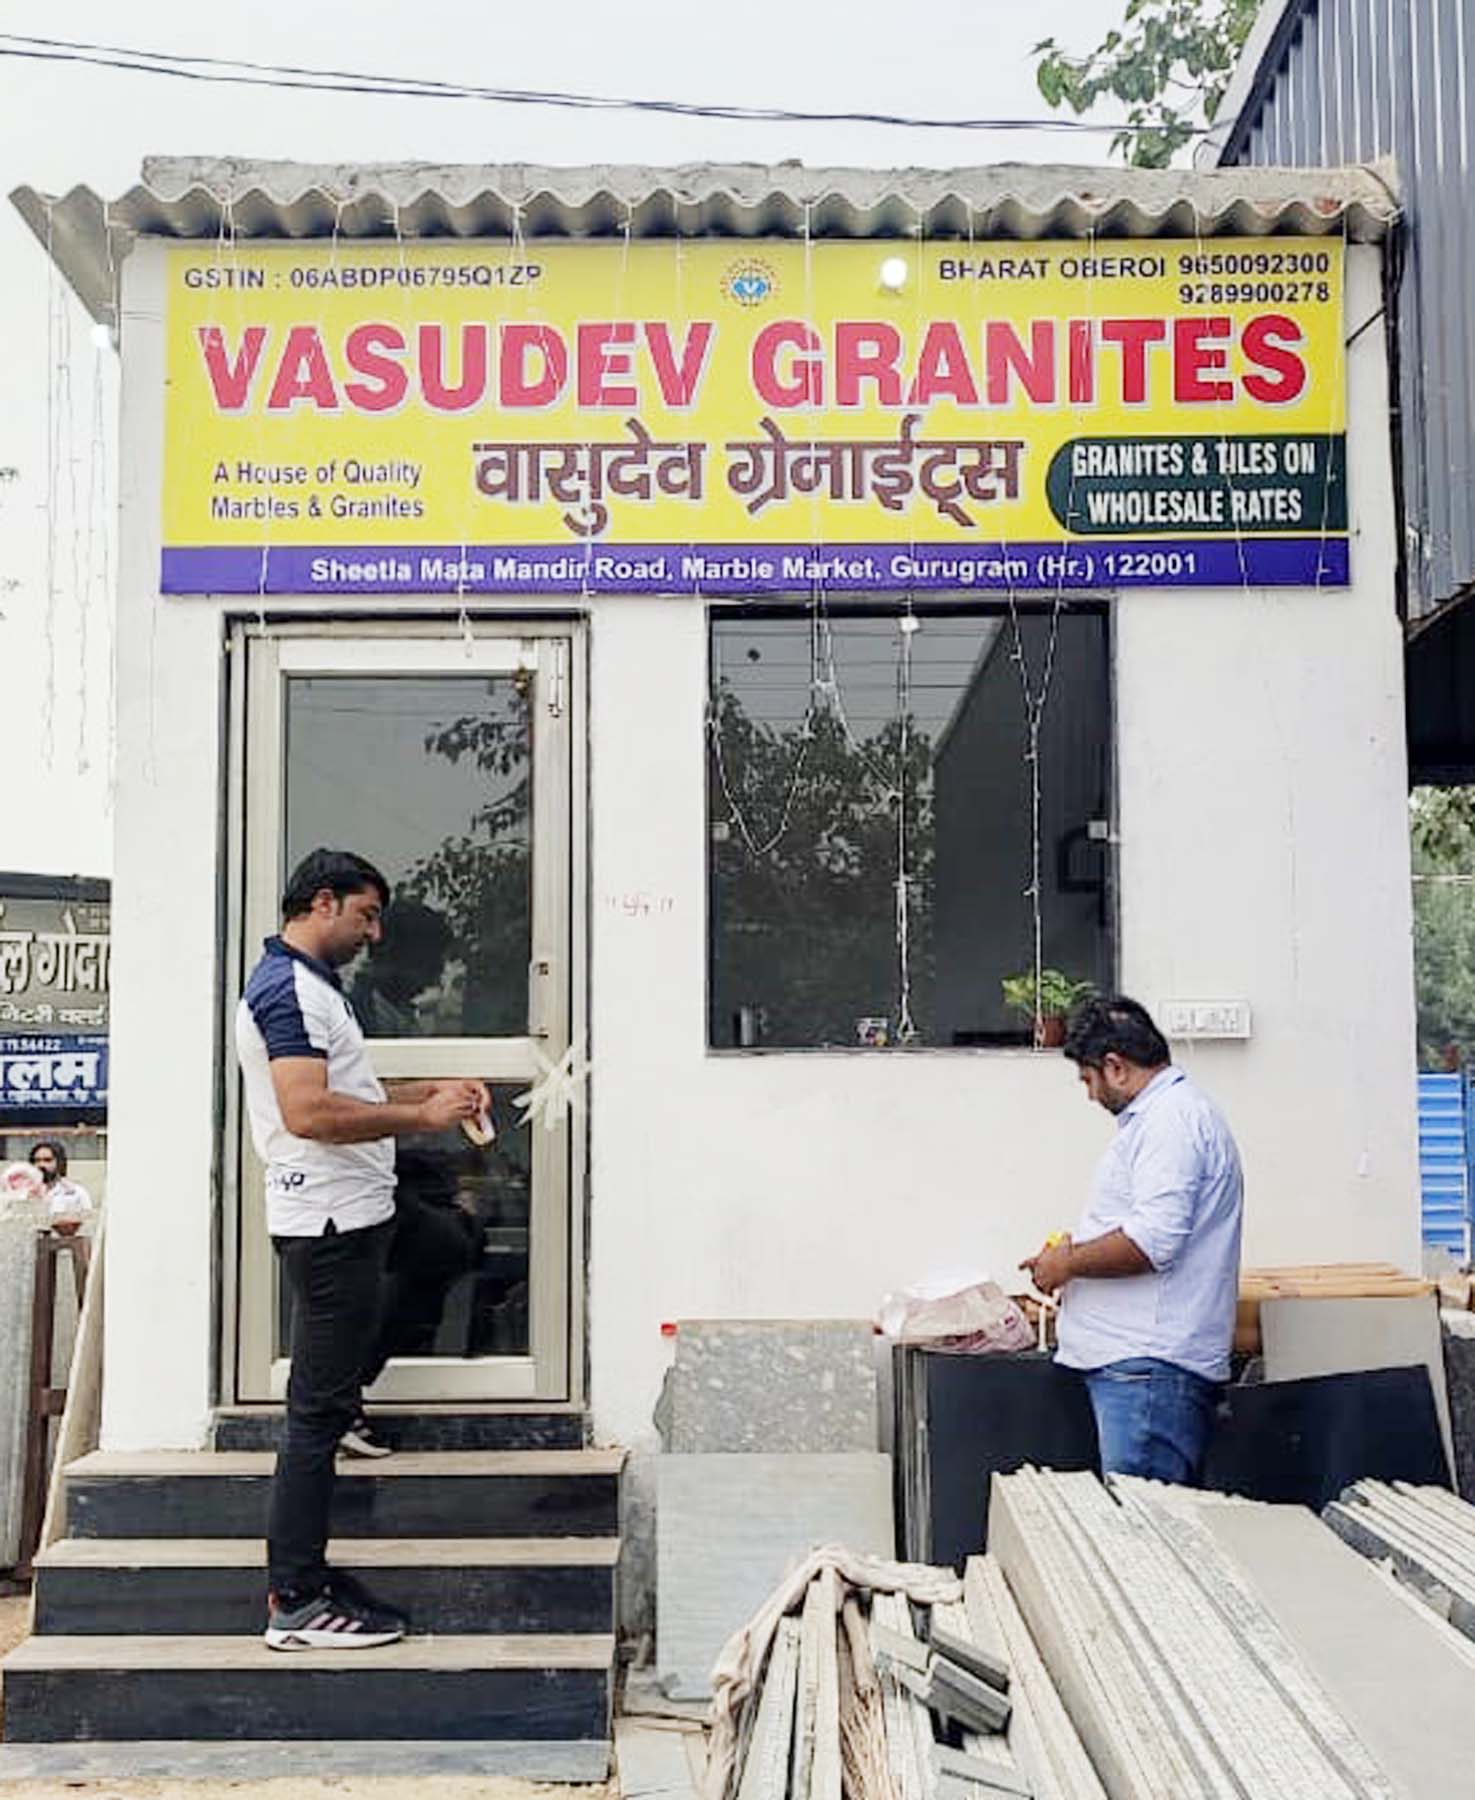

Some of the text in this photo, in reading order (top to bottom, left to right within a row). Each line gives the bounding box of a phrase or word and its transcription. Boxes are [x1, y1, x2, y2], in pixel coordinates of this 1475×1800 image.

[184, 267, 265, 289] GSTIN
[939, 252, 1329, 280] BHARAT OBEROI 9650092300
[1179, 281, 1330, 304] 9289900278
[198, 316, 1307, 411] VASUDEV GRANITES
[214, 459, 422, 489] A House of Quality
[1073, 441, 1316, 477] GRANITES & TILES ON
[472, 417, 707, 537] वासुदेव
[212, 494, 424, 519] Marbles & Granites
[1087, 488, 1302, 524] WHOLESALE RATES
[311, 553, 1197, 583] Sheetla Mata Mandir Road, Marble Market, Gurugram (Hr.) 122001
